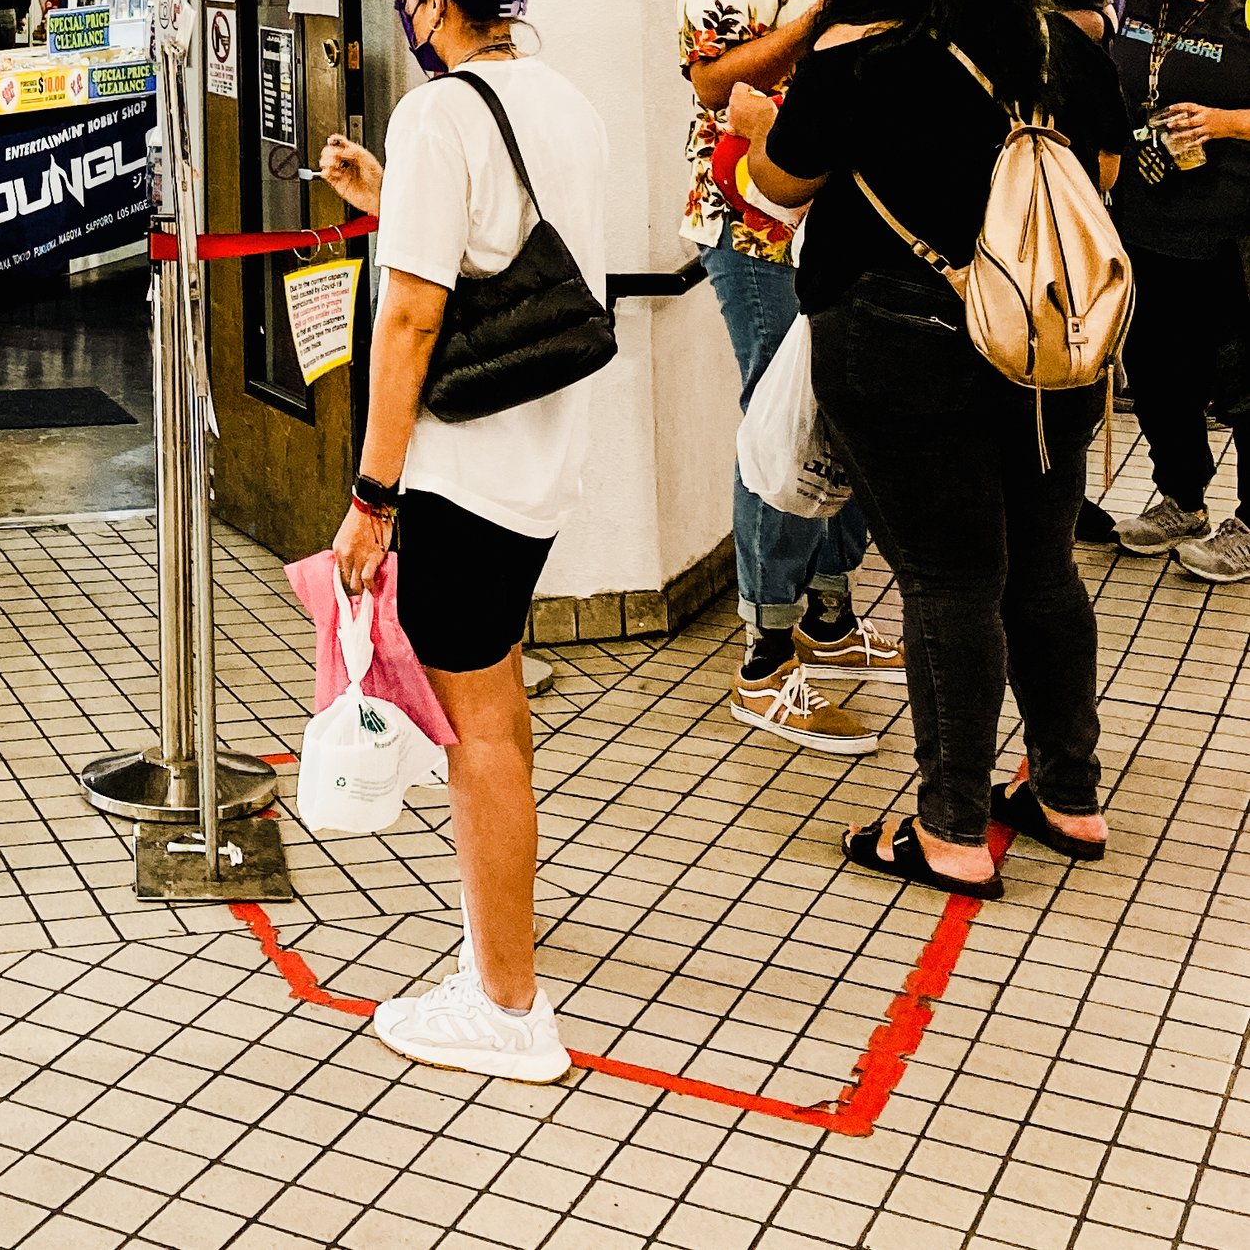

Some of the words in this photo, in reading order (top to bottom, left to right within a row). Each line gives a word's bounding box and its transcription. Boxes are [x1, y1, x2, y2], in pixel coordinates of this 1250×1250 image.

[49, 14, 84, 33] SPECIAL
[85, 12, 110, 30] PRICE
[55, 30, 105, 50] CLEARANCE
[93, 69, 126, 83] SPECIAL
[127, 64, 150, 78] PRICE
[38, 76, 65, 94] $10.00
[97, 79, 145, 95] CLEARANCE
[88, 111, 118, 133] HOBBY
[121, 101, 147, 120] SHOP
[59, 227, 82, 244] NAGOYA
[86, 214, 113, 234] SAPPORO
[117, 206, 129, 220] LOS
[131, 199, 150, 214] ANGE
